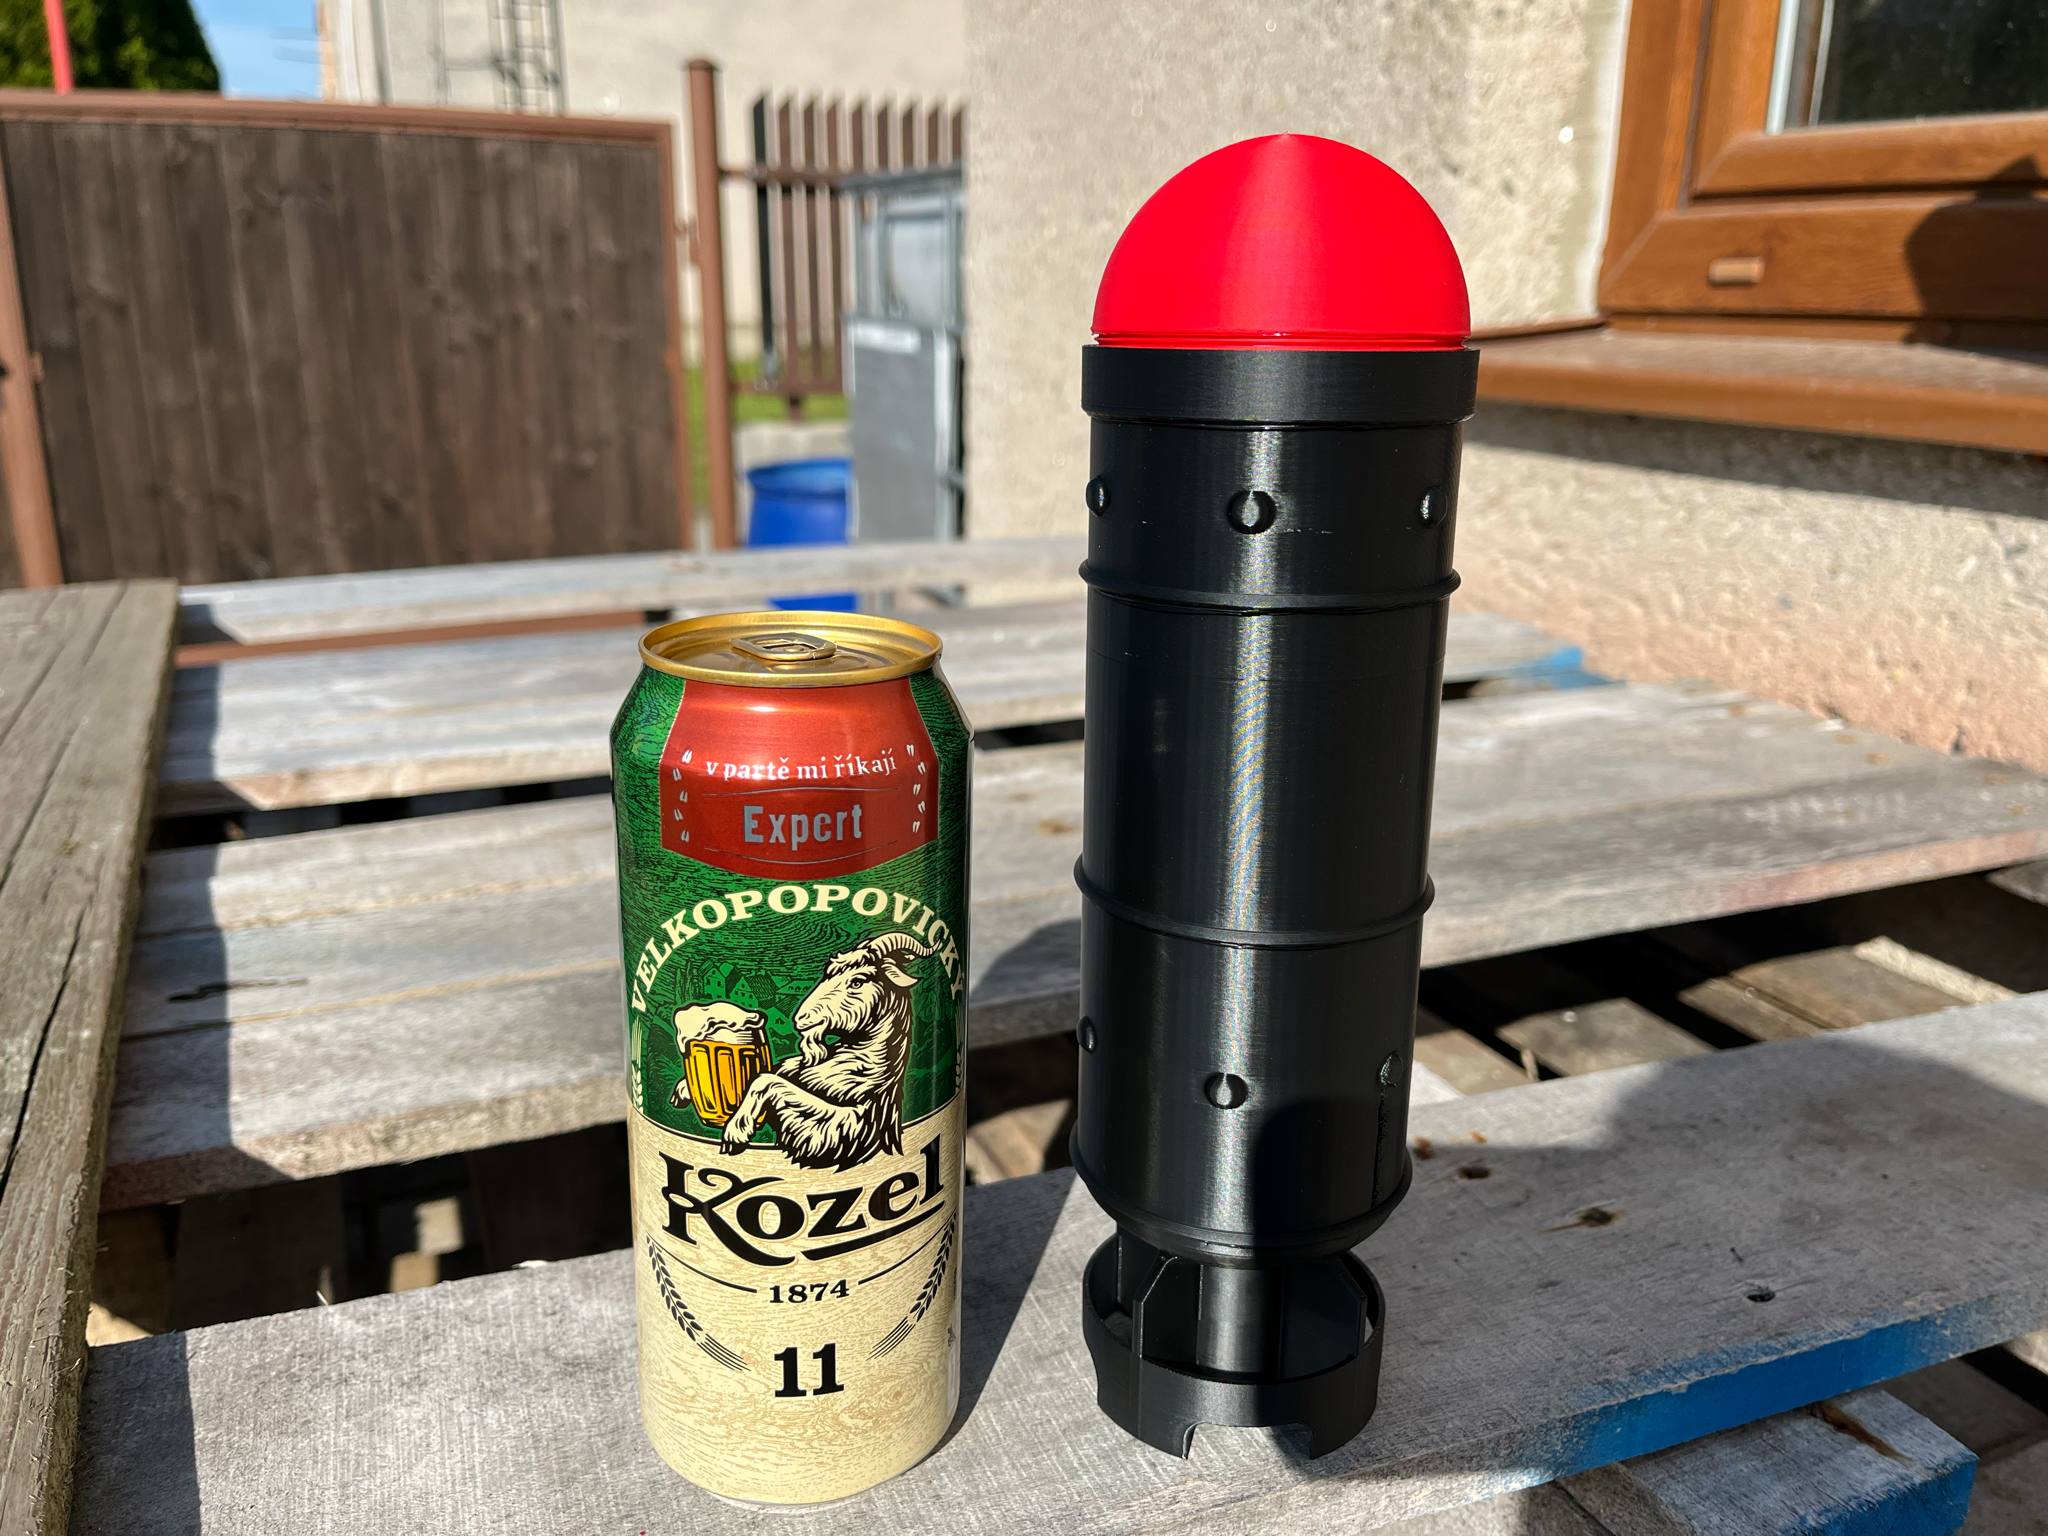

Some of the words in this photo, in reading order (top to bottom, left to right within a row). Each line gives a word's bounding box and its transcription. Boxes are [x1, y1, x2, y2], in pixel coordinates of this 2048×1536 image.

[706, 760, 718, 775] v
[724, 757, 790, 780] partě
[797, 756, 827, 779] mi
[834, 748, 896, 777] říkají
[743, 804, 862, 851] Expert
[659, 1133, 945, 1267] Kozel
[769, 1279, 850, 1303] 1874
[774, 1342, 845, 1397] 11
